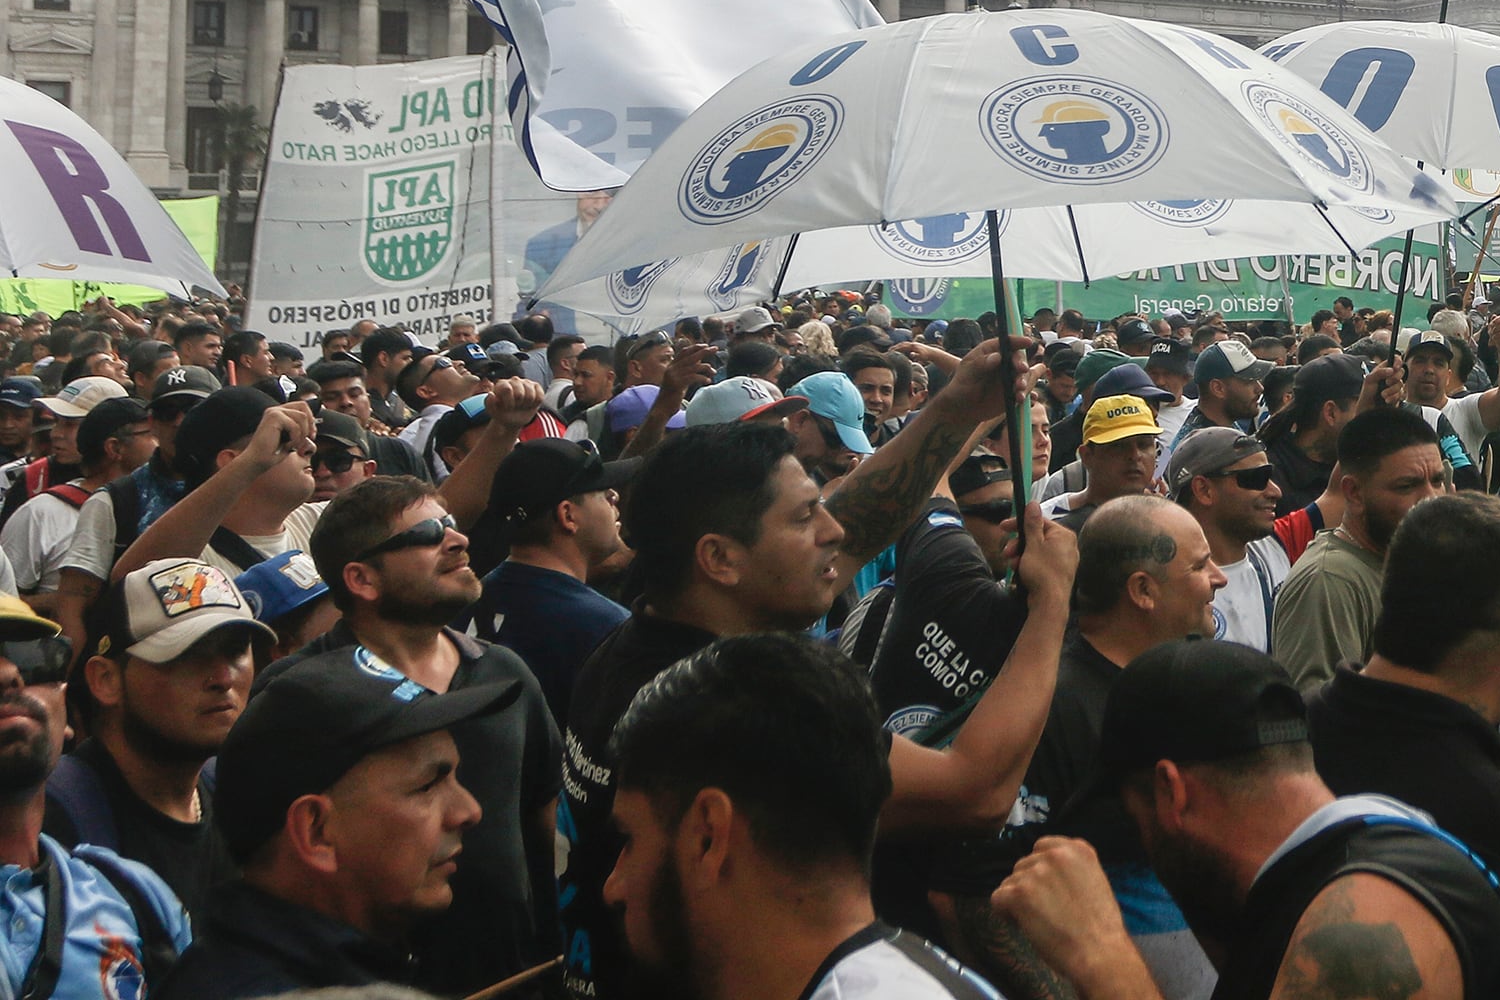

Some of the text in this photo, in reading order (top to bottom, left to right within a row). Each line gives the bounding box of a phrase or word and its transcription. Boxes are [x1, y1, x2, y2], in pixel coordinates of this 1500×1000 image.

[744, 104, 811, 130] SIEMPRE
[803, 107, 828, 157] GERARDO
[996, 83, 1150, 175] SIEMPRE UOCRA SIEMPRE GERARDO MARTINEZ
[697, 130, 741, 173] UOCRA
[724, 160, 804, 212] MARTINEZ
[1107, 404, 1140, 419] UOCRA
[915, 642, 958, 688] COMO
[923, 621, 957, 659] QUE
[949, 651, 970, 677] LA
